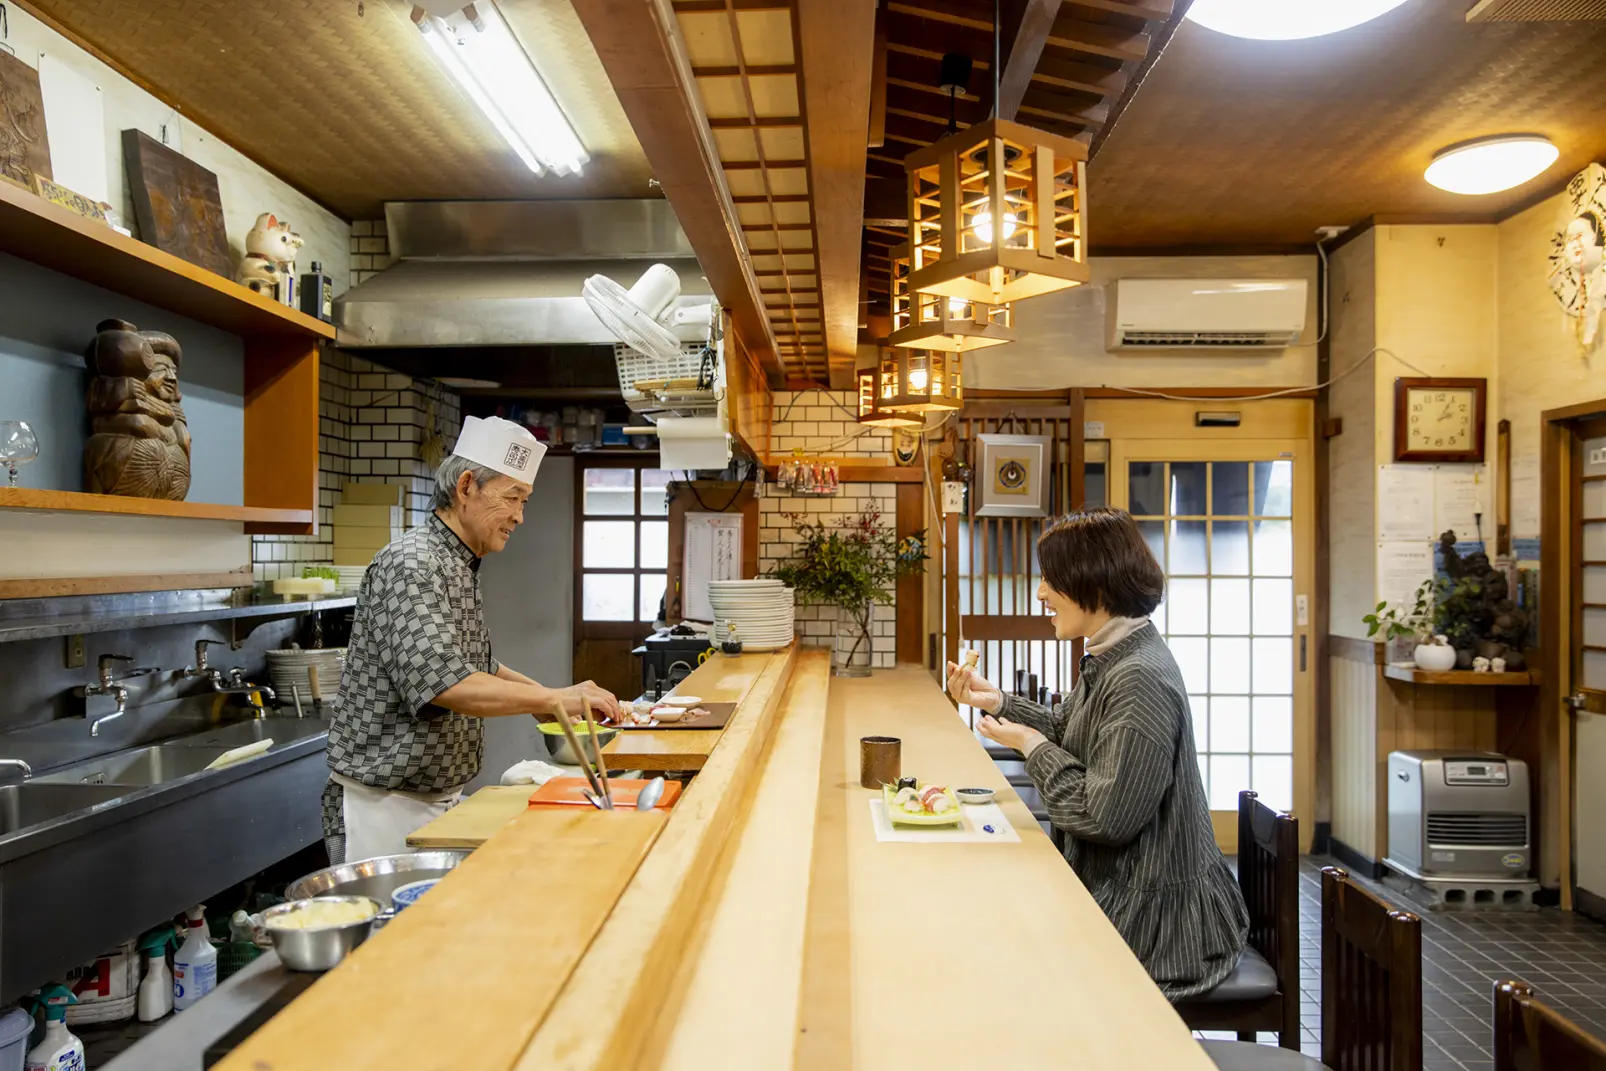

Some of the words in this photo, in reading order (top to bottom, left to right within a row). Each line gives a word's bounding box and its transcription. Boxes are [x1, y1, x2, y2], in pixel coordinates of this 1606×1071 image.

[1435, 393, 1446, 402] 12
[1458, 404, 1467, 412] 2
[1411, 415, 1419, 424] 9
[1461, 416, 1469, 425] 3
[1412, 428, 1420, 437] 8
[1423, 436, 1431, 445] 7
[1434, 438, 1444, 447] 6
[1448, 436, 1456, 445] 5
